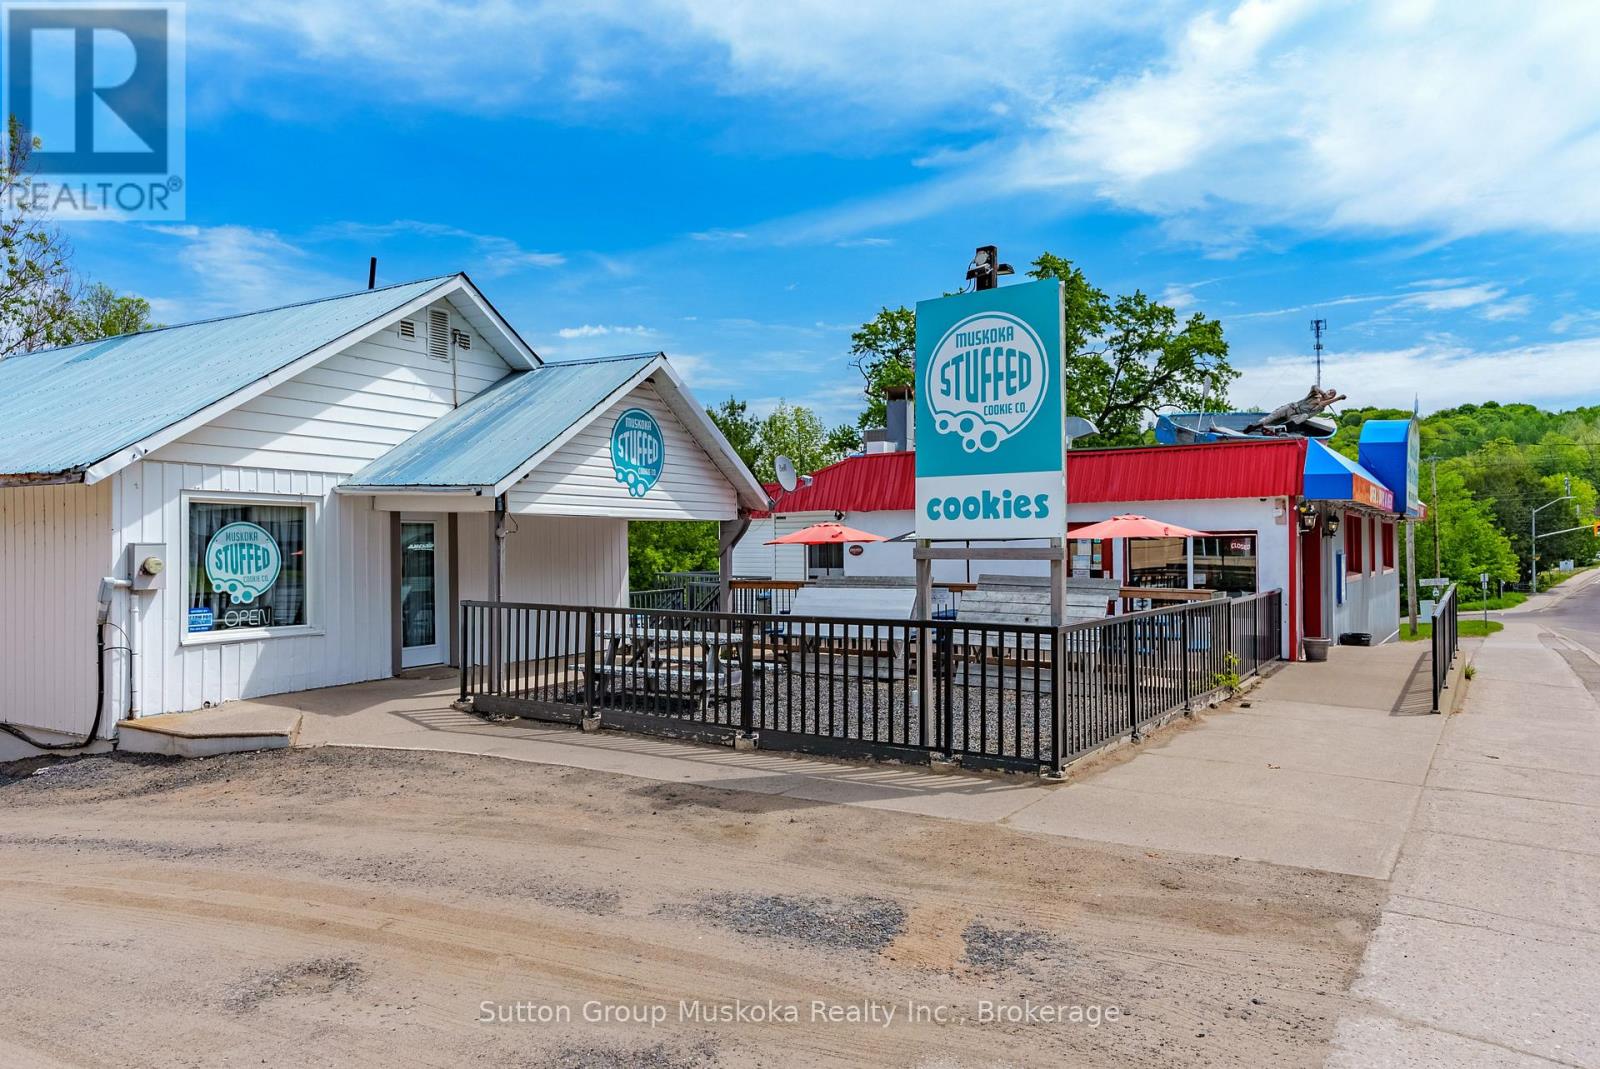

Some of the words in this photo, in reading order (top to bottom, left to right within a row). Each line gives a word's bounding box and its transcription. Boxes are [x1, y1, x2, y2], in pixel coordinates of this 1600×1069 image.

[956, 326, 1014, 348] MUSKOKA
[940, 346, 1032, 403] STUFFED
[984, 403, 1013, 416] COOKIE
[1015, 402, 1028, 414] CO.
[618, 430, 658, 466] STUFFED
[926, 489, 1050, 521] cookies
[225, 531, 258, 542] MUSKOKA
[1231, 542, 1251, 551] CLOSED
[215, 542, 271, 576] STUFFED
[225, 608, 271, 627] OPEN
